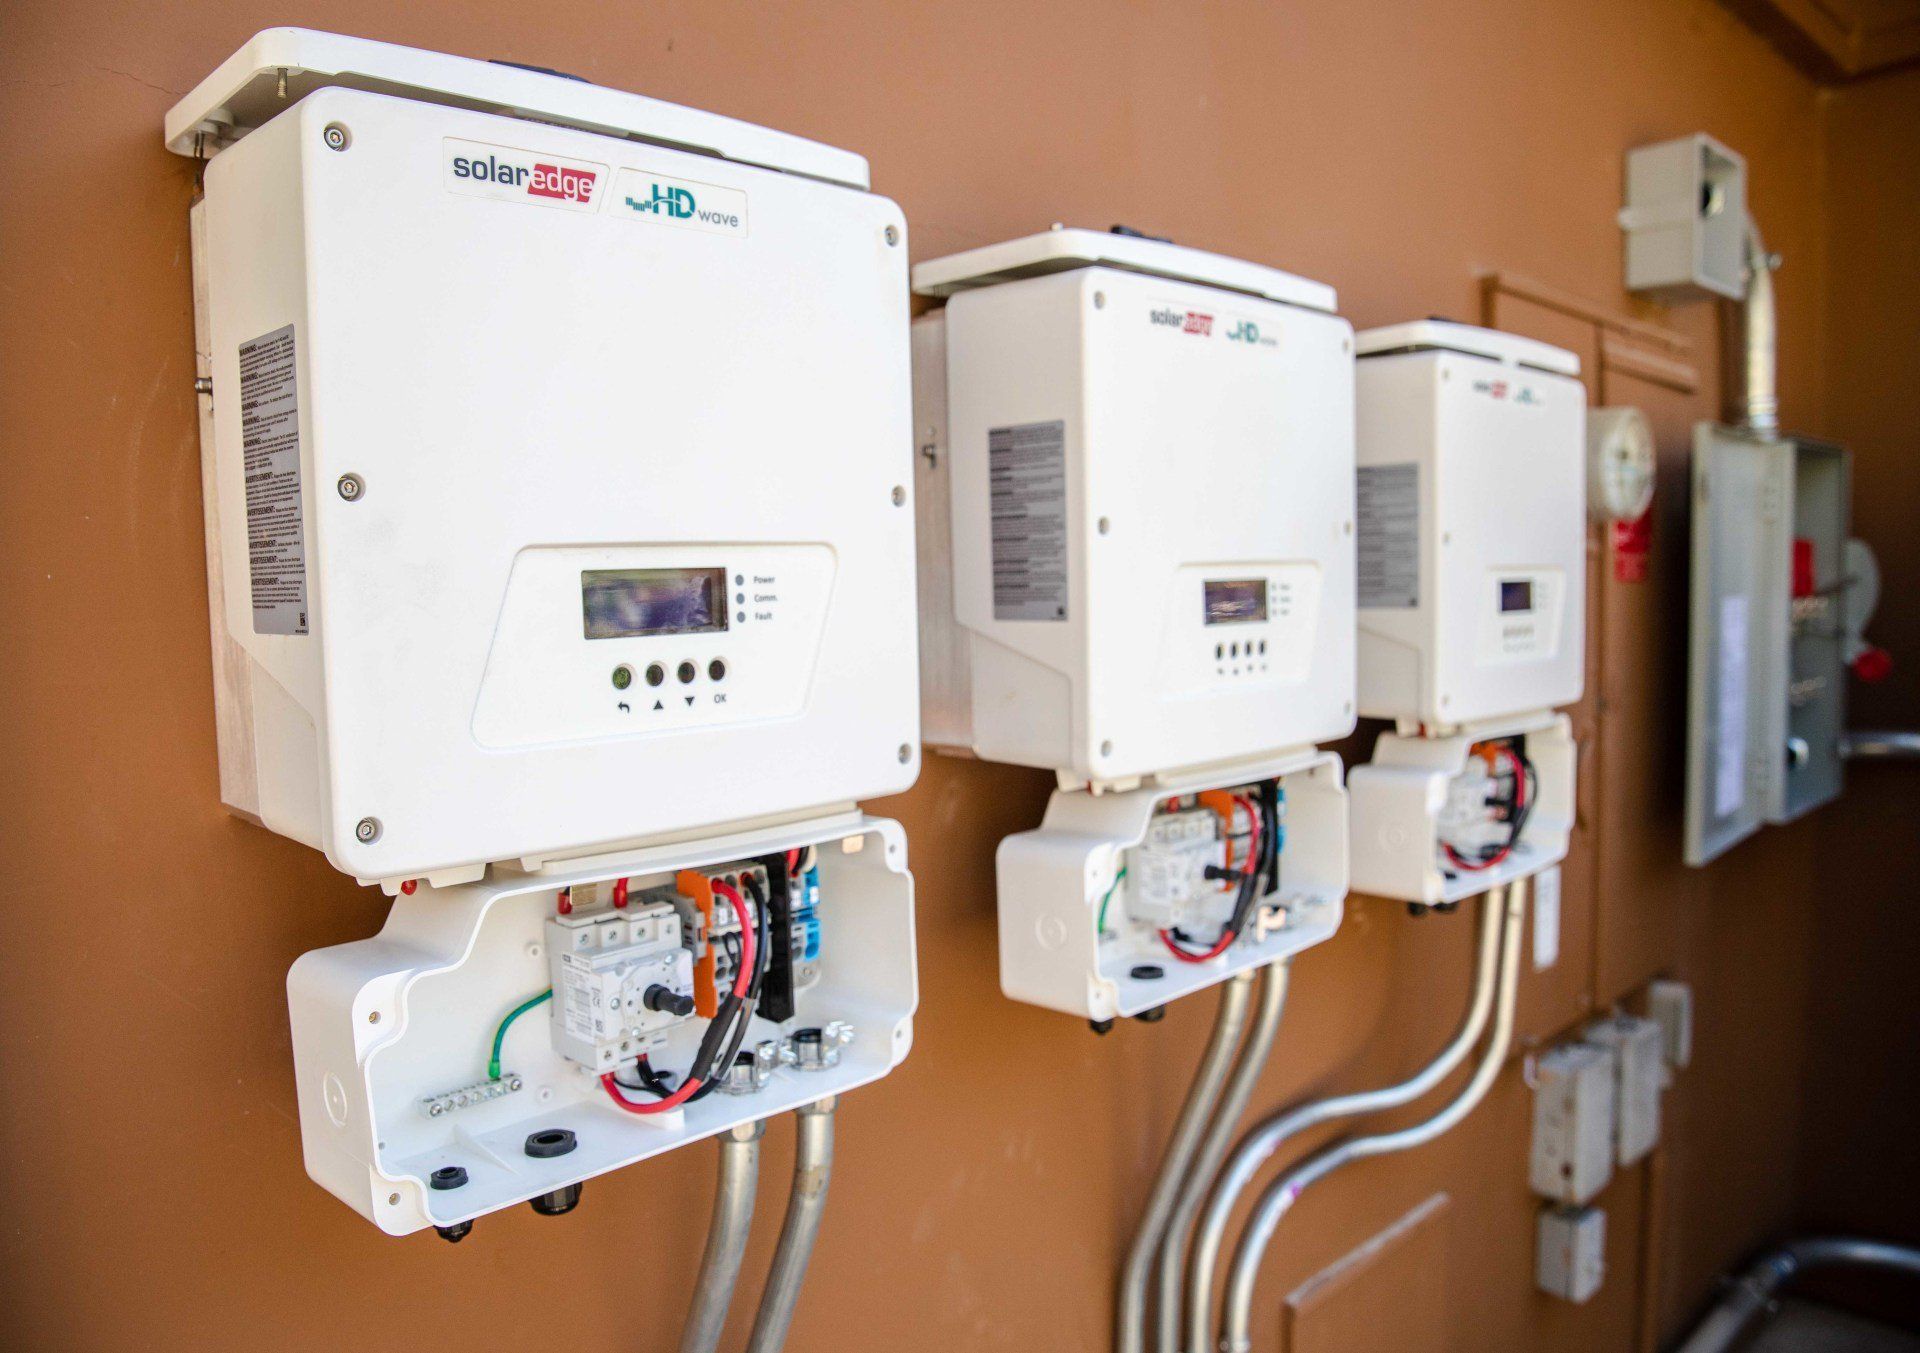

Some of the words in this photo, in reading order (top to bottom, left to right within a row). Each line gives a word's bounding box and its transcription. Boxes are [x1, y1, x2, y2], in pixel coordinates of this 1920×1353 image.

[453, 155, 594, 201] solaredge
[652, 184, 696, 218] HD
[698, 209, 738, 228] wave
[753, 576, 775, 585] Power
[754, 594, 778, 603] Comm.
[755, 612, 772, 621] Fault
[714, 694, 727, 704] OK
